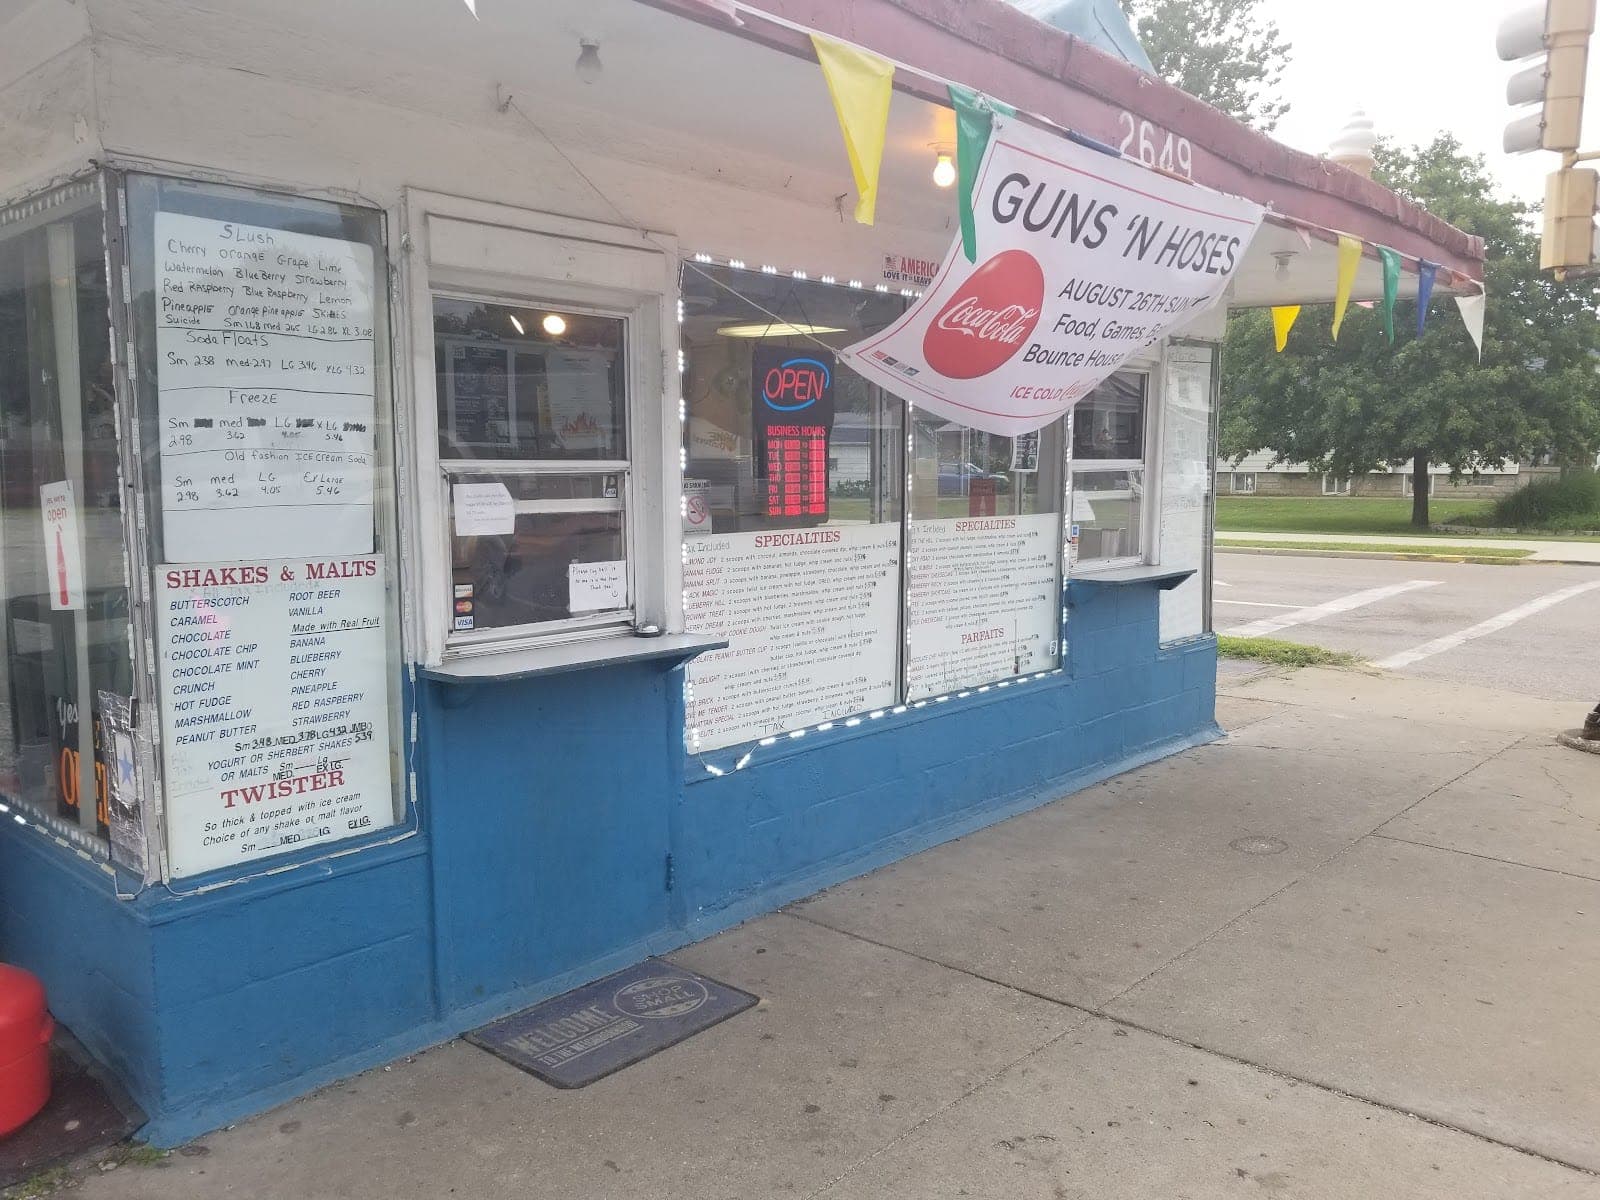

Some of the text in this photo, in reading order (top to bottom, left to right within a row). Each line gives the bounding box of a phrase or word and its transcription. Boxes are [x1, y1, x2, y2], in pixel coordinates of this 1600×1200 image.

[992, 173, 1118, 249] GUNS
[1164, 226, 1240, 277] HOSES
[168, 239, 206, 257] Cherry
[277, 254, 309, 268] Grape
[884, 271, 899, 280] LOVE
[902, 273, 907, 281] IT
[163, 278, 184, 293] Red
[243, 286, 266, 298] Blue
[319, 293, 352, 305] Lemon
[1058, 278, 1133, 308] AUGUST
[1129, 292, 1168, 312] 26TH
[165, 314, 200, 325] Suicide
[1053, 313, 1100, 339] Food,
[186, 330, 218, 344] Soda
[167, 352, 188, 366] Sm
[281, 360, 295, 370] LG
[1022, 343, 1085, 367] Bounce
[765, 368, 824, 400] OPEN
[1010, 385, 1030, 399] ICE
[1033, 385, 1061, 400] COLD
[169, 418, 188, 428] Sm
[275, 417, 291, 428] LG
[768, 425, 825, 436] BUSINESS HOURS
[224, 450, 245, 461] Old
[175, 476, 193, 487] Sm
[259, 473, 277, 482] LG
[48, 508, 67, 522] open
[955, 520, 1016, 532] SPECIALTIES
[755, 531, 841, 548] SPECIALTIES
[166, 561, 377, 589] SHAKES & MALTS
[170, 590, 340, 610] BUTTERSCOTCH ROOT BEER
[171, 607, 323, 627] CARAMEL VANILLA
[172, 617, 380, 644] CHOCOLATE Made with Real Fruit
[961, 628, 1005, 645] PARFAITS
[172, 637, 326, 660] CHOCOLATE CHIP BANANA
[172, 651, 341, 678] CHOCOLATE MINT BLUEBERRY
[173, 668, 326, 695] CRUNCH CHERRY
[175, 682, 338, 712] HOT FUDGE PINEAPPLE
[175, 693, 364, 728] MARSHMALLOW RED RASPBERRY
[176, 710, 350, 745] PEANUT BUTTER STRAWBERRY
[208, 752, 246, 771] YOGURT
[251, 752, 264, 763] OR
[268, 744, 315, 760] SHERBERT
[319, 739, 352, 751] SHAKES
[235, 743, 250, 752] Sm
[221, 771, 235, 782] OR
[239, 765, 268, 779] MALTS
[280, 763, 293, 771] Sm
[221, 771, 345, 808] TWISTER
[204, 793, 361, 832] So thick & topped with ice cream
[203, 834, 235, 846] Choice
[241, 829, 250, 837] of
[254, 825, 270, 836] any
[275, 819, 300, 830] shake
[318, 811, 335, 820] malt
[340, 805, 363, 816] flavor
[241, 844, 256, 853] Sm
[632, 984, 684, 1002] SHOP
[634, 990, 696, 1010] SMALL
[503, 1004, 622, 1056] WELCOME
